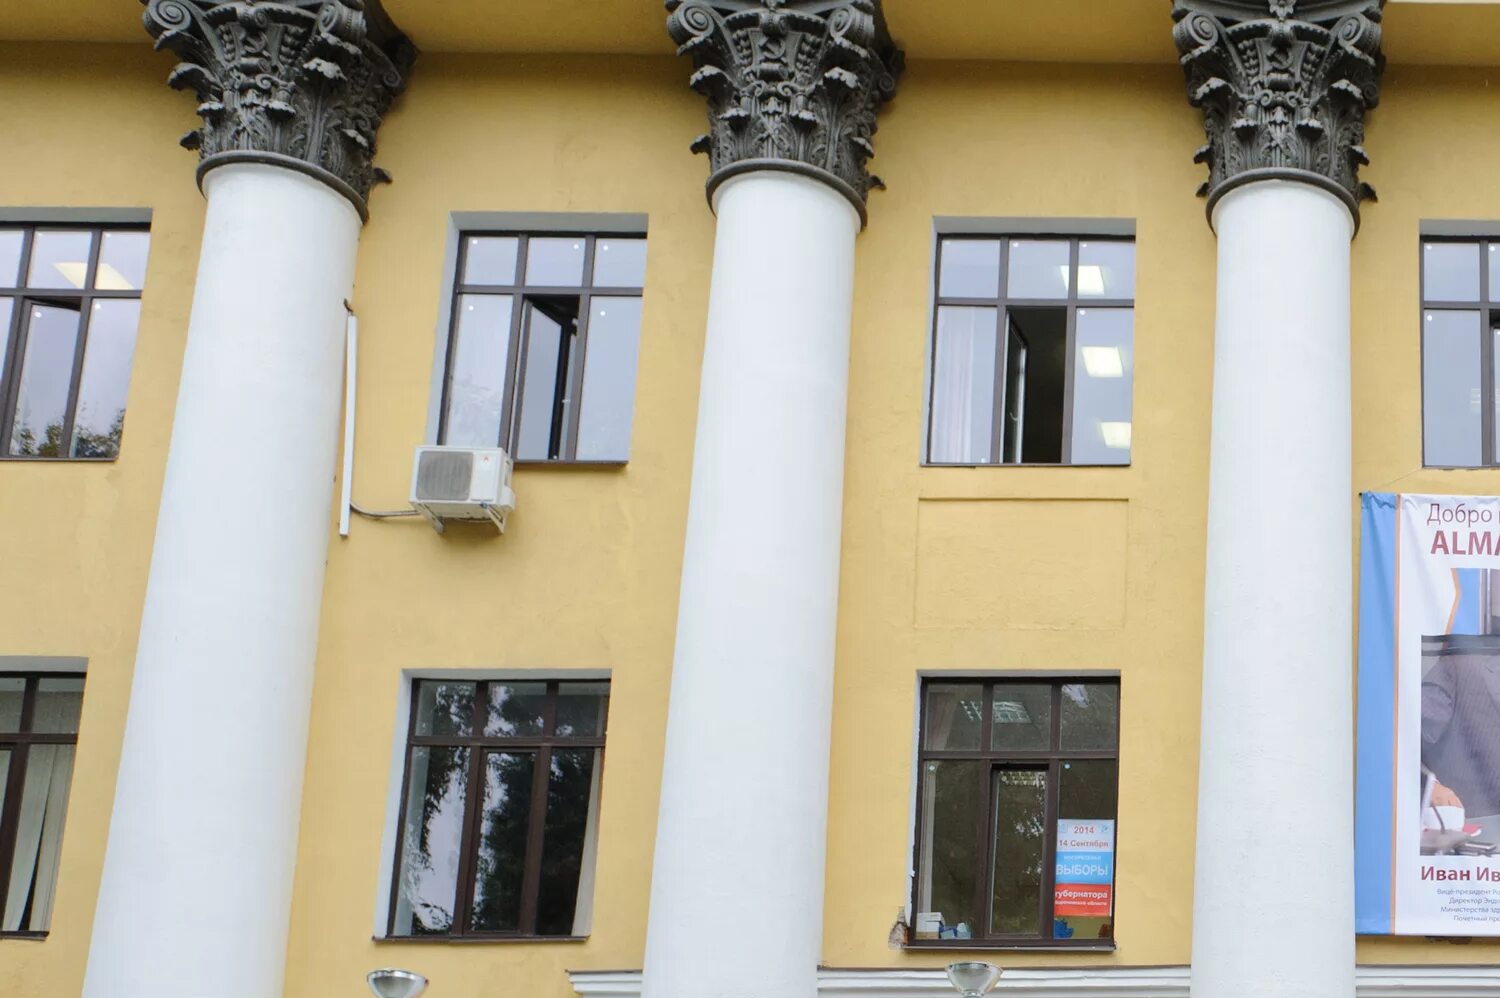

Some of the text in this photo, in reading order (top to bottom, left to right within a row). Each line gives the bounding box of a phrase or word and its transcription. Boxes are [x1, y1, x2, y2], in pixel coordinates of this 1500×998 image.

[1427, 504, 1492, 527] Добро
[1073, 826, 1095, 834] 2014
[1070, 840, 1109, 848] Сентября
[1056, 864, 1108, 876] ВЫБОРЫ
[1420, 866, 1471, 881] Иван
[1055, 890, 1108, 899] губернатора
[1436, 888, 1491, 897] Вице-президент
[1448, 897, 1483, 905] Директор
[1440, 906, 1489, 914] Министерства
